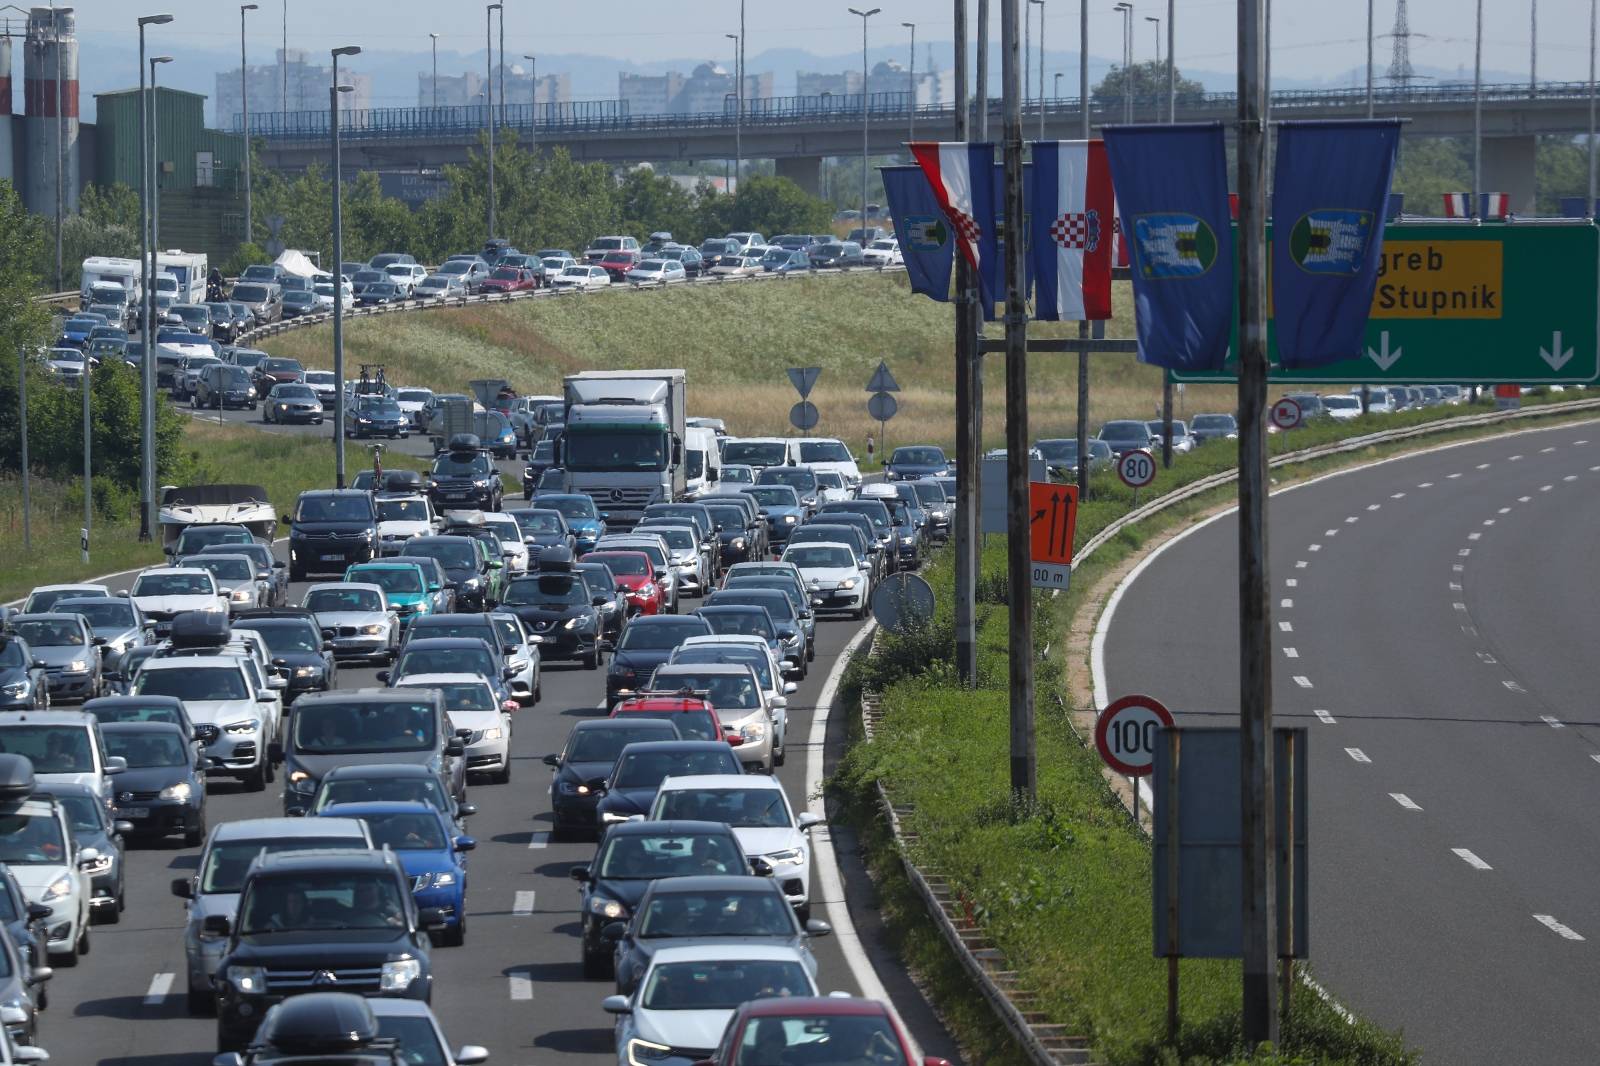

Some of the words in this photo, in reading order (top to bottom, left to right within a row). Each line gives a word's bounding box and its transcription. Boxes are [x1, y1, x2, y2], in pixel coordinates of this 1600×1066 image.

[1379, 284, 1496, 315] Stupnik
[1126, 459, 1149, 479] 80
[1053, 573, 1064, 583] m
[1112, 720, 1159, 754] 100
